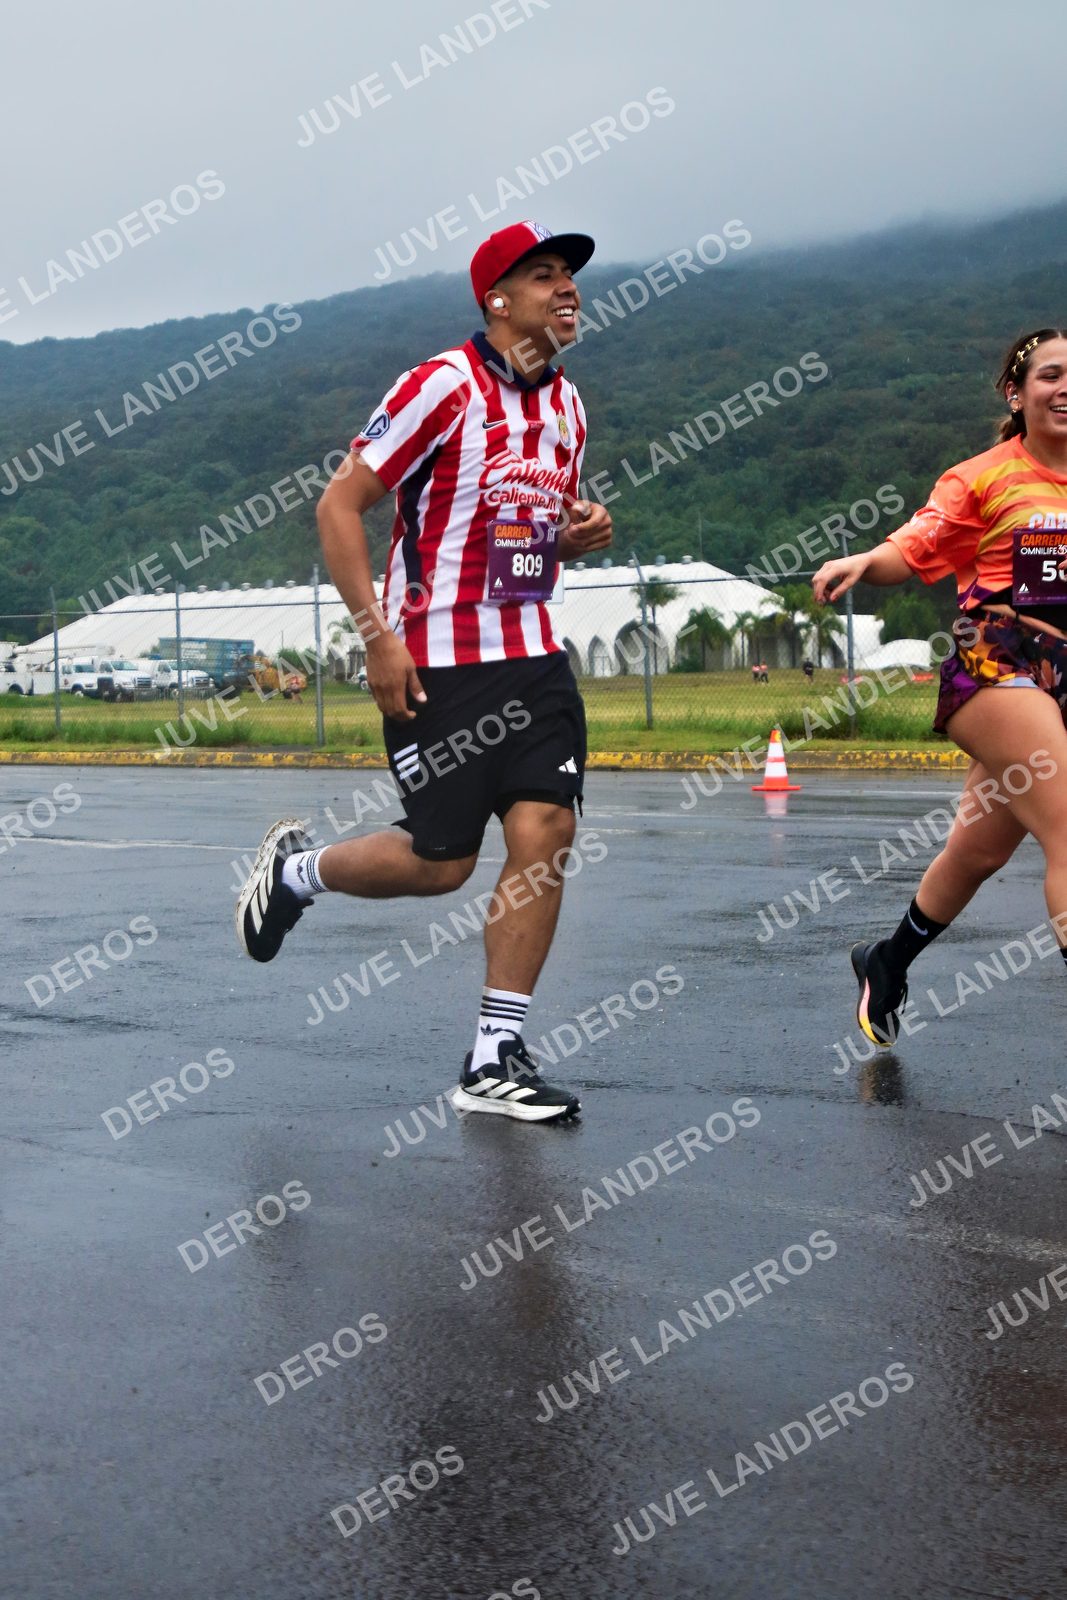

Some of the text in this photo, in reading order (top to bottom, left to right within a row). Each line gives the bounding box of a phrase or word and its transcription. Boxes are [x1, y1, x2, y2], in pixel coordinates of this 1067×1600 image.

[479, 449, 569, 494] Caliente
[495, 525, 532, 538] CARRERA
[512, 553, 543, 577] 809
